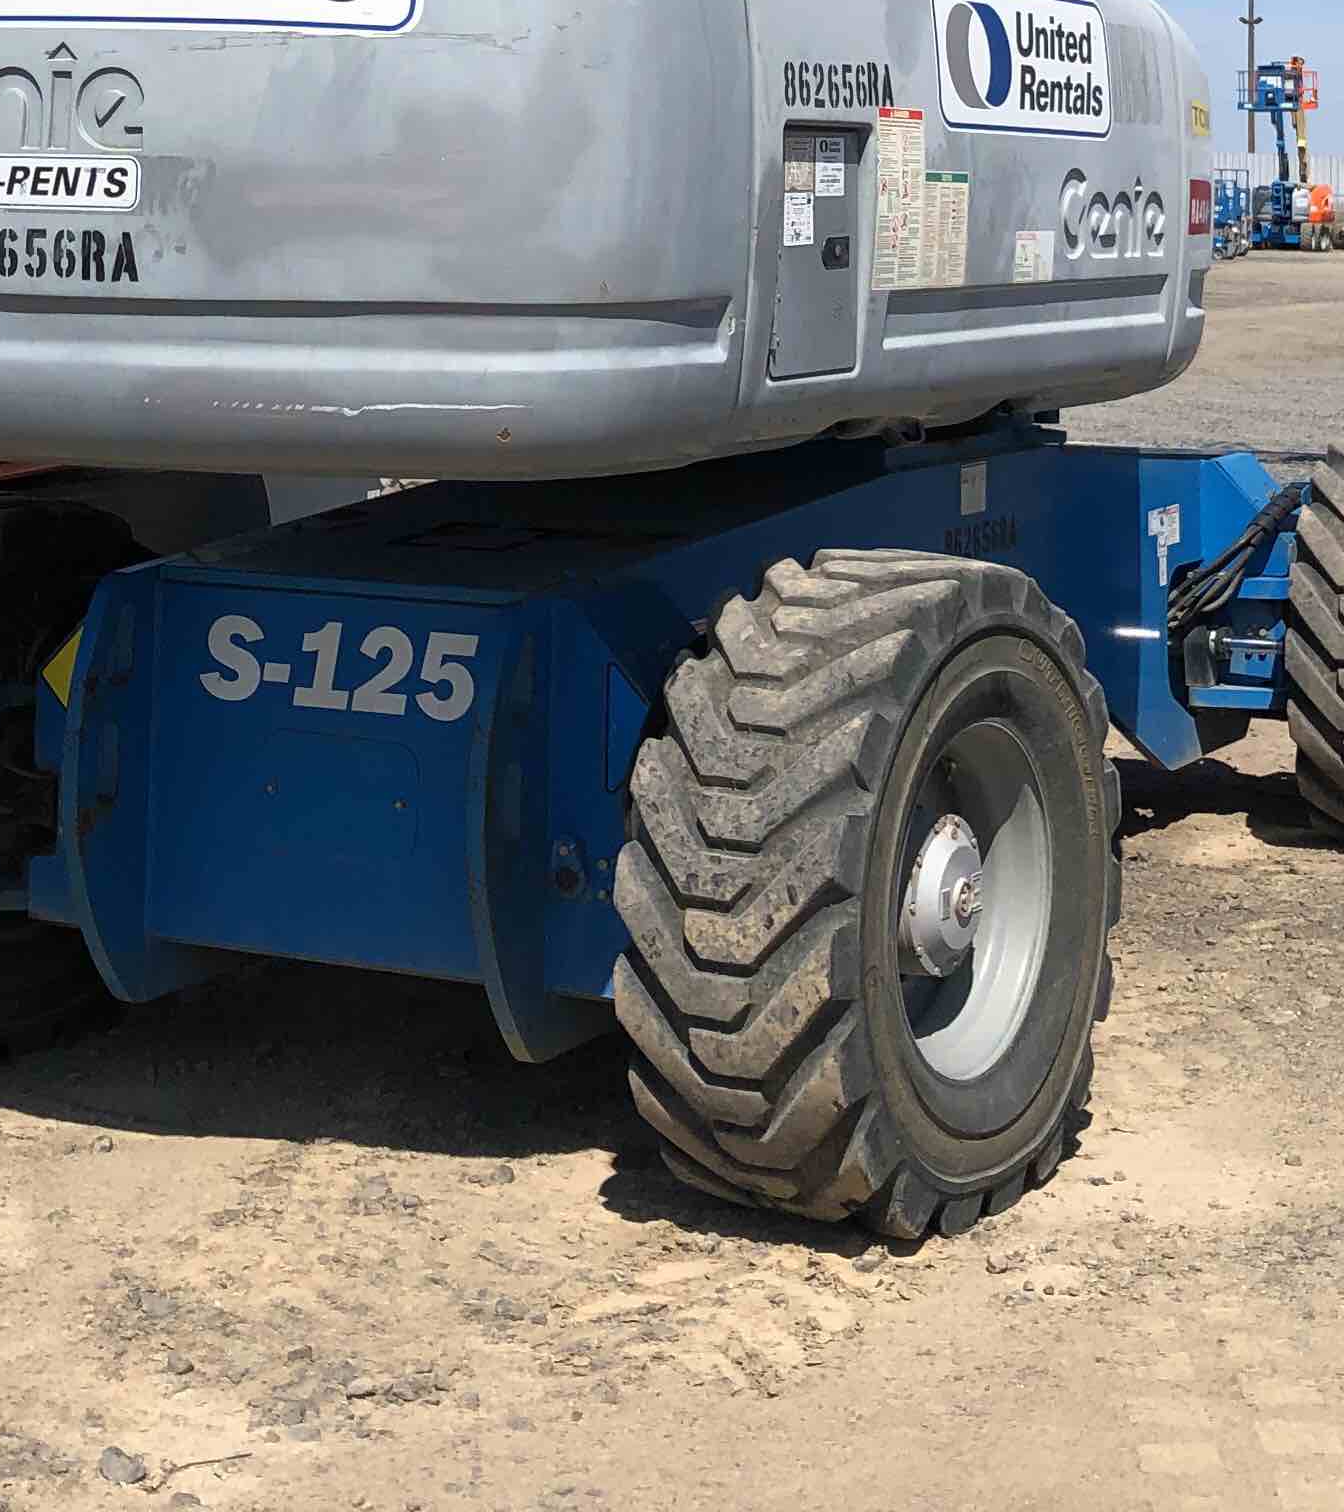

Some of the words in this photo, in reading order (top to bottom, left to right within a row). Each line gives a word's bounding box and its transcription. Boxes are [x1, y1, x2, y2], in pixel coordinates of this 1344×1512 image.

[1015, 10, 1093, 66] United
[783, 61, 894, 109] 862656RA
[1019, 64, 1104, 117] Rentals
[1059, 167, 1166, 260] Genie
[199, 614, 481, 722] S-125
